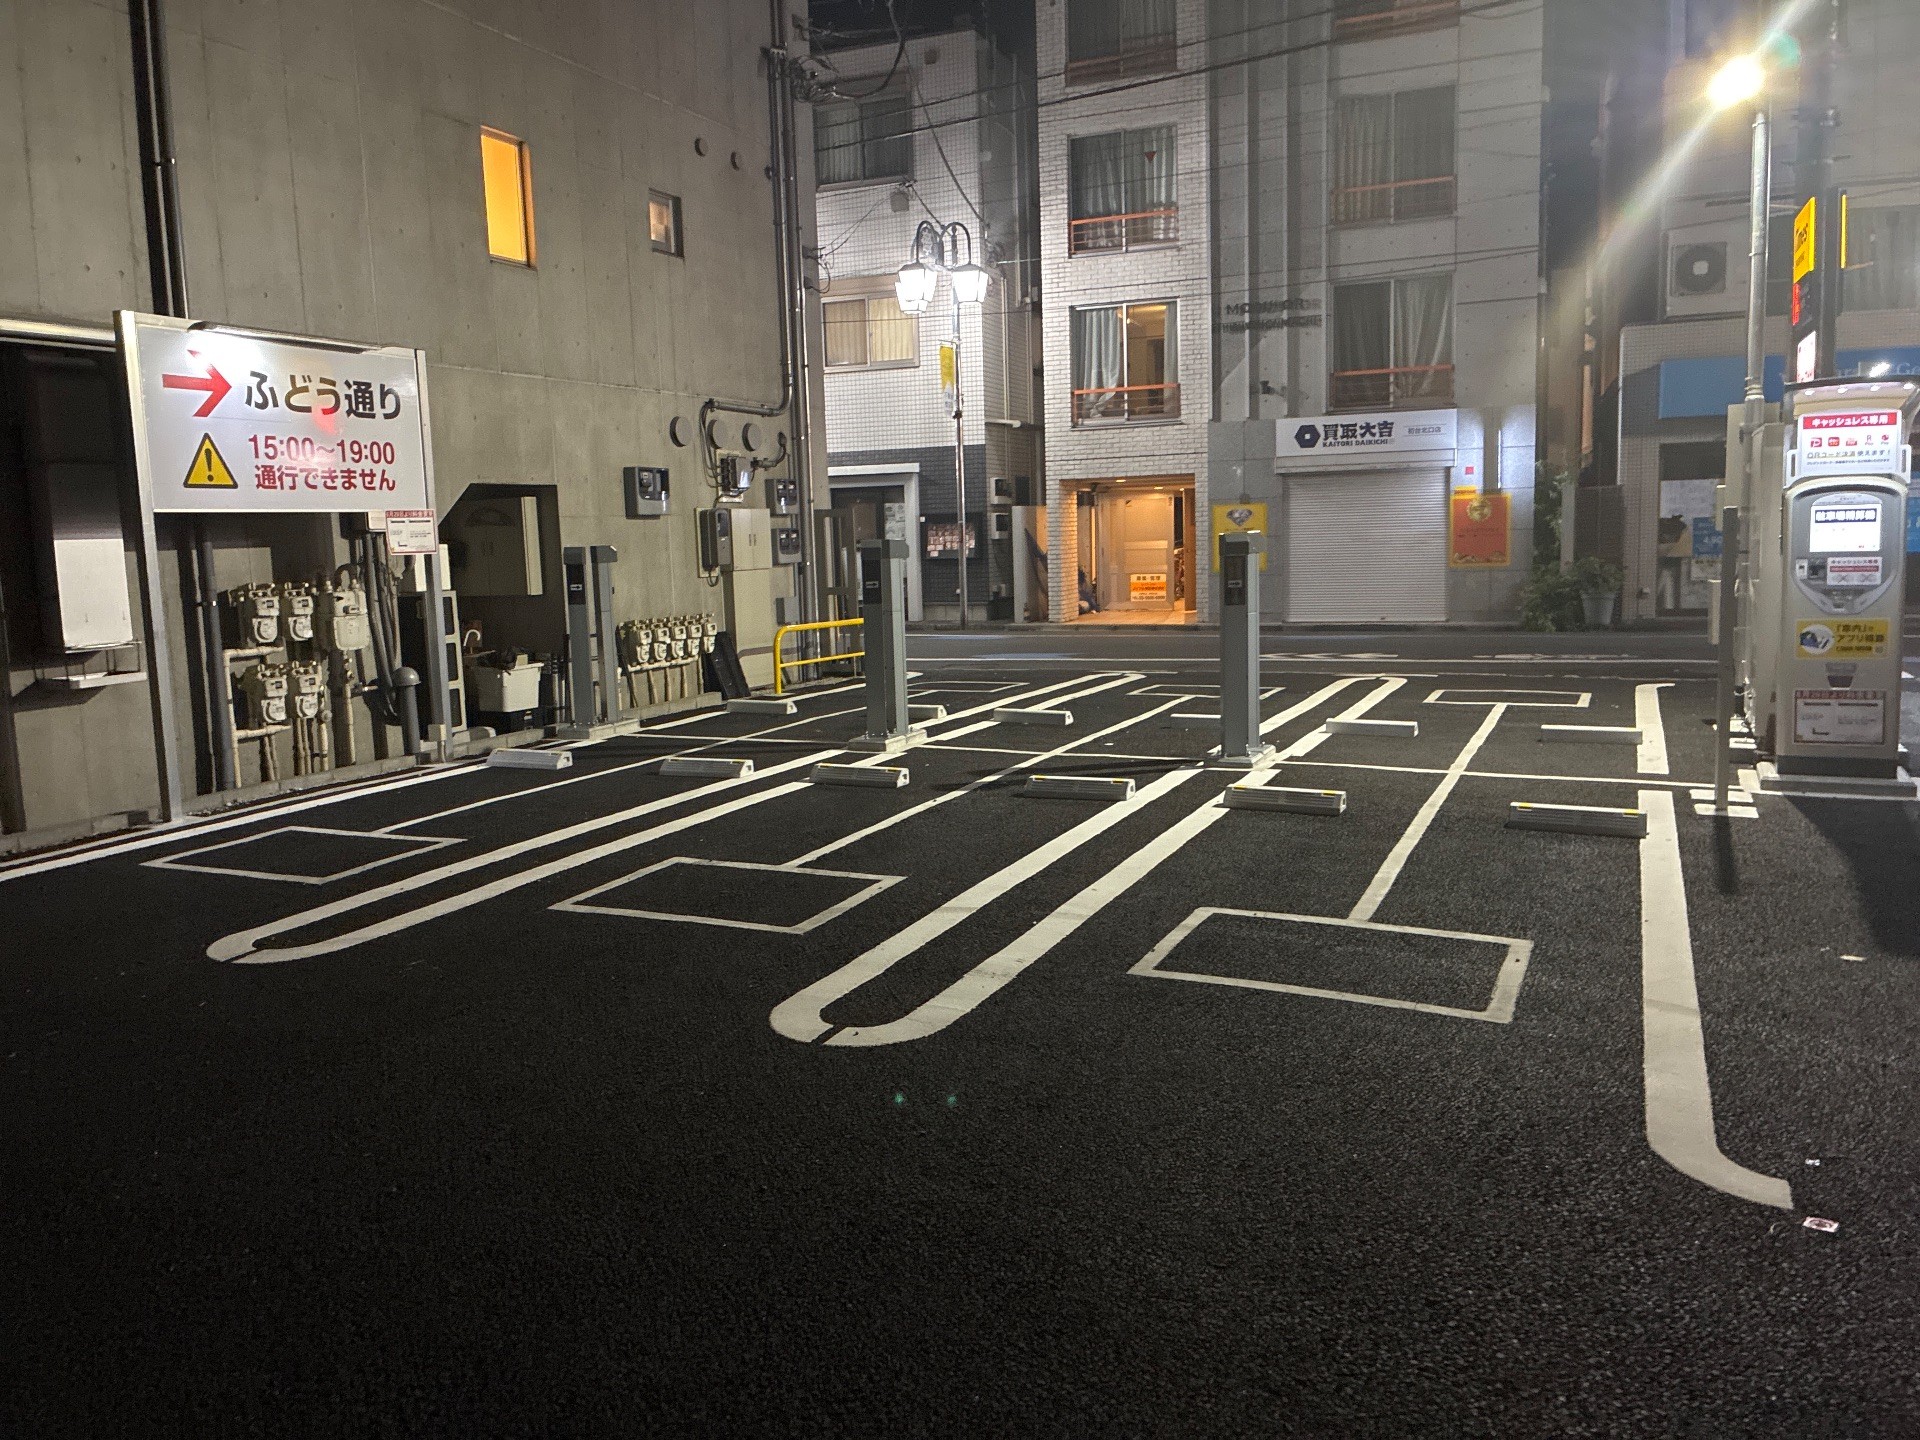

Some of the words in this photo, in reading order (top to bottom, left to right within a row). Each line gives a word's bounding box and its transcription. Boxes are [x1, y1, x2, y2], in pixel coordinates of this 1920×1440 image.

[244, 370, 401, 420] ふどう通り
[1322, 420, 1394, 441] 買取大吉
[1811, 414, 1889, 427] キャッシュレス専用
[1322, 440, 1353, 448] KAITORI
[1355, 438, 1388, 446] DAIKICHI
[255, 464, 396, 491] 通行できません
